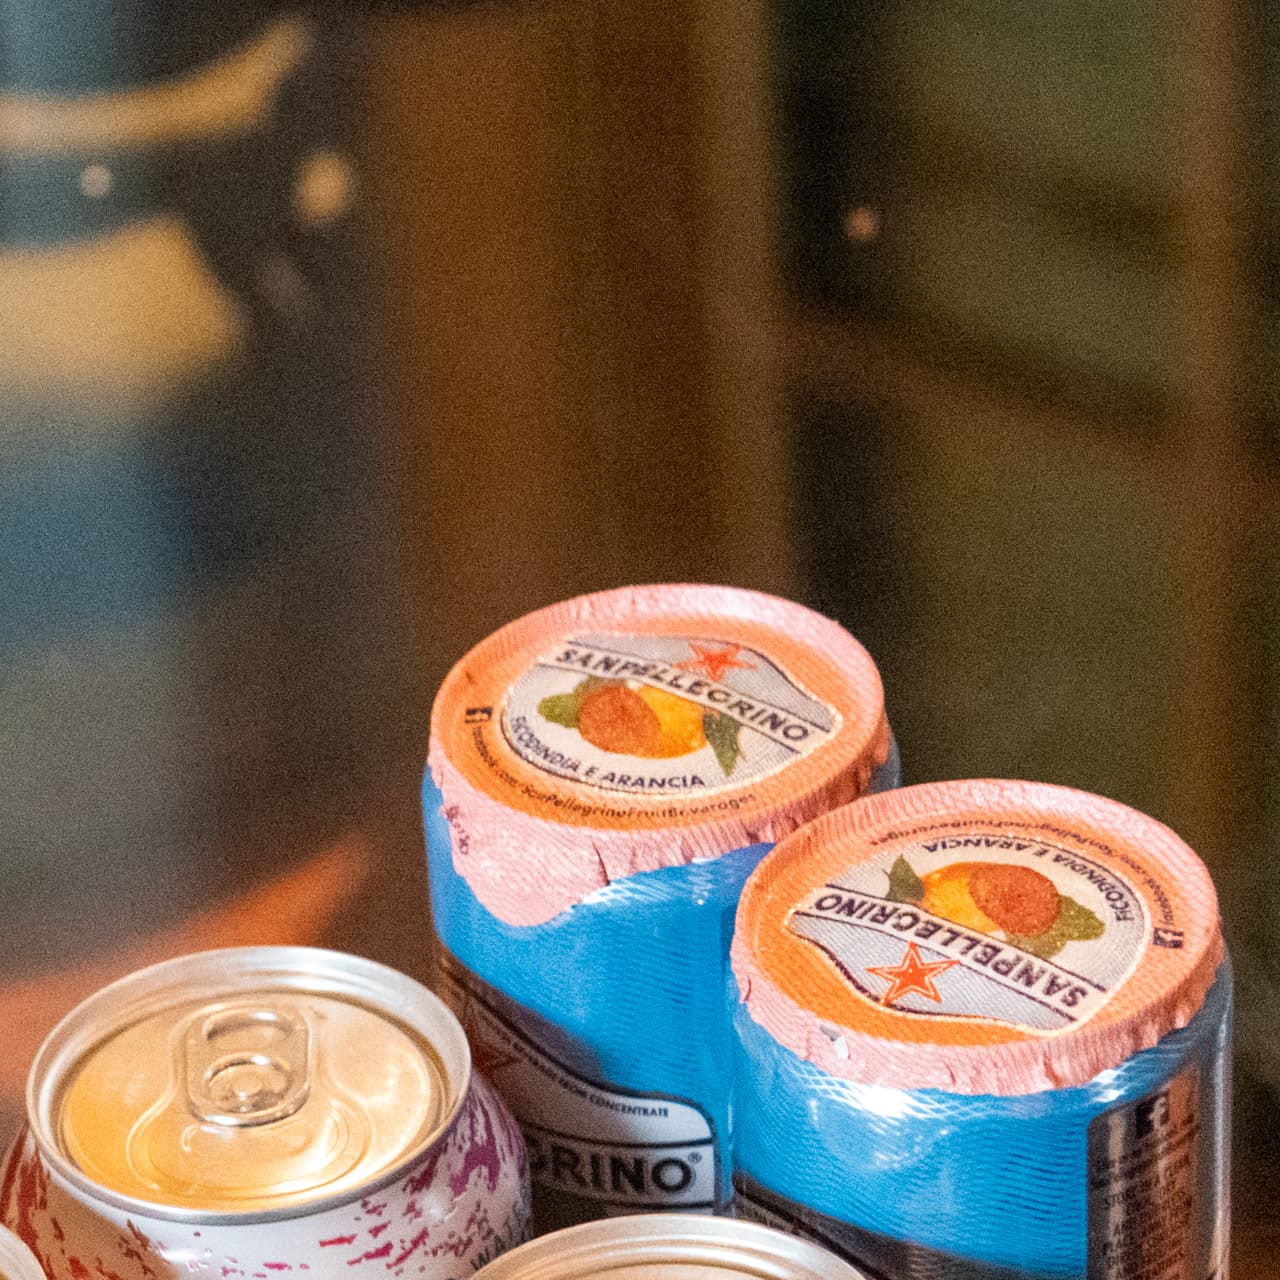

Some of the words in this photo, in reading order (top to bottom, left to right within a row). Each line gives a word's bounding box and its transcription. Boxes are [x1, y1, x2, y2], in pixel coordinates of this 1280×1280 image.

[555, 646, 812, 744] SANPELLEGRINO
[601, 771, 706, 790] ARANCIA
[922, 837, 1031, 854] ARANCIA
[1051, 850, 1135, 923] FICODINDIA
[814, 893, 1089, 1009] SANPELLEGRINO
[590, 1095, 670, 1118] CONCENTRATE
